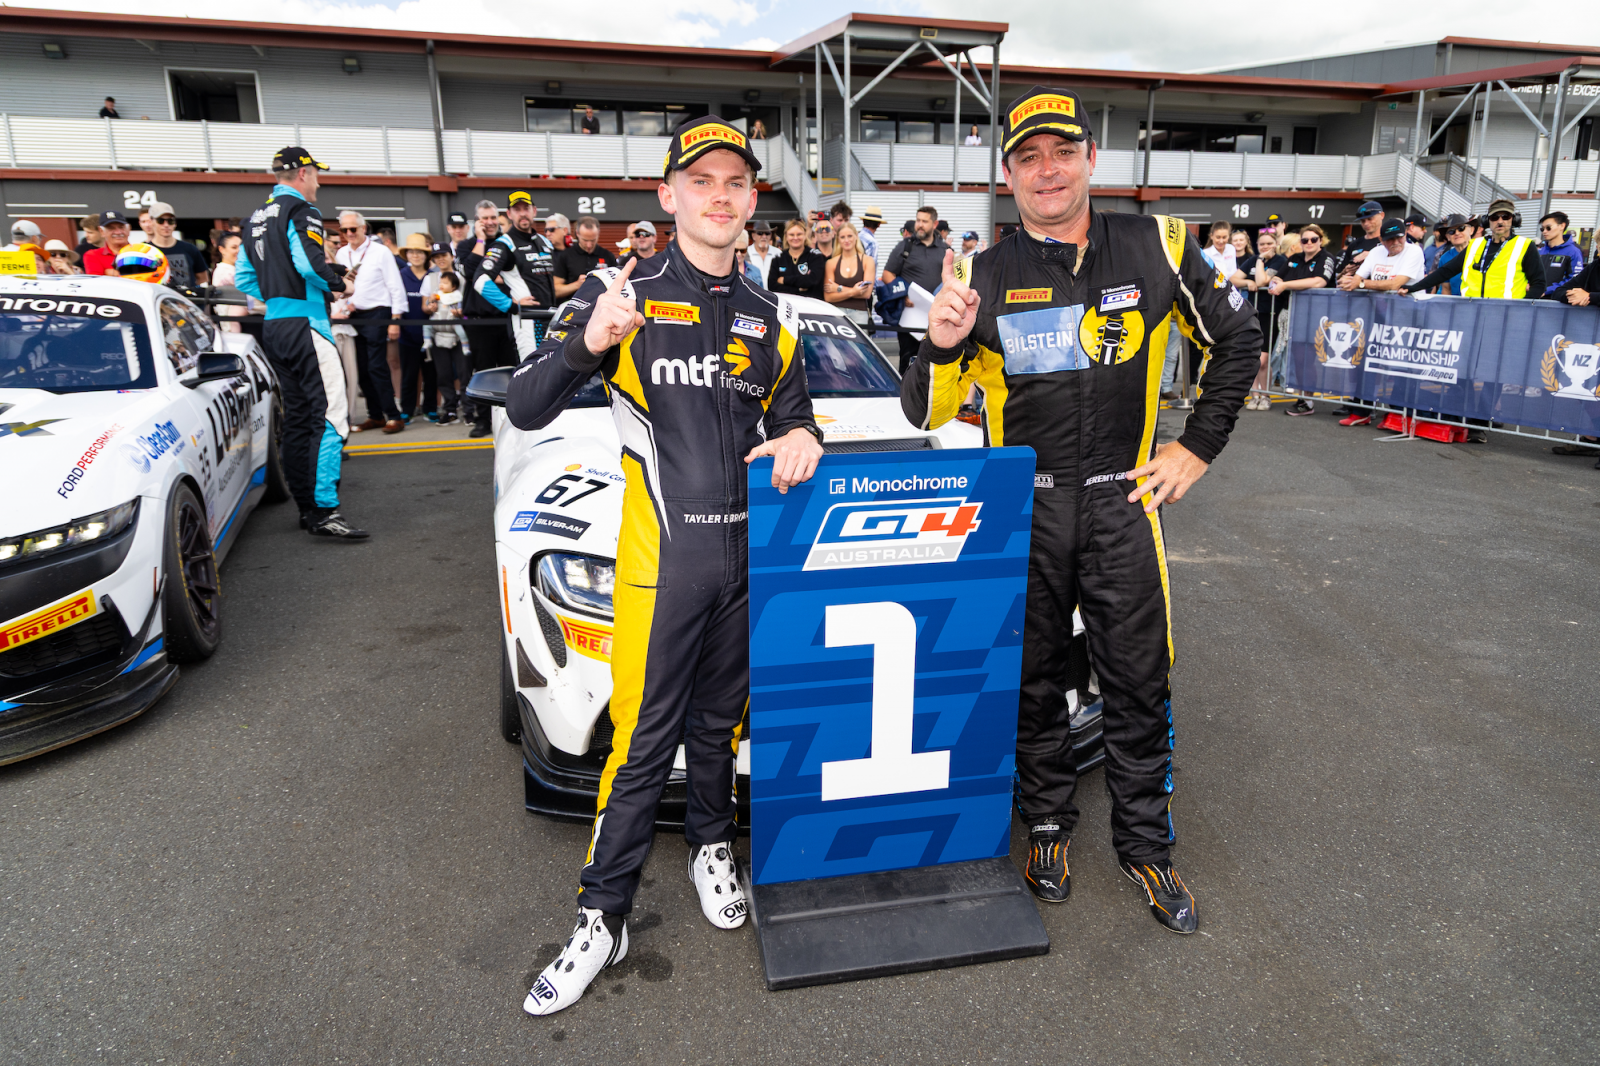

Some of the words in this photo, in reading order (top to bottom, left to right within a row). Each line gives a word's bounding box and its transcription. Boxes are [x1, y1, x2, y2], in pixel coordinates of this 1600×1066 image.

[1013, 97, 1070, 125] PIRELLI
[684, 126, 743, 147] PIRELLI
[123, 190, 158, 209] 24
[578, 197, 606, 213] 22
[1232, 204, 1250, 218] 18
[1308, 205, 1325, 218] 17
[1, 263, 31, 271] FERME
[1010, 290, 1048, 301] PIRELLI
[650, 304, 694, 320] PIRELLI
[1004, 330, 1074, 354] BILSTEIN
[1335, 330, 1347, 342] NZ
[1368, 323, 1464, 352] NEXTGEN
[1366, 343, 1460, 367] CHAMPIONSHIP
[1571, 353, 1592, 368] NZ
[651, 353, 721, 388] mtf
[1428, 368, 1455, 380] Repco
[719, 371, 766, 397] finance
[585, 468, 609, 477] Shell
[609, 474, 626, 483] Car
[852, 475, 968, 494] Monochrome
[1084, 473, 1115, 487] JEREMY
[1115, 471, 1130, 480] GR
[534, 473, 611, 508] 67
[536, 518, 584, 533] SILVER-AM
[684, 514, 721, 523] TAYLER
[839, 506, 980, 538] GT4
[823, 546, 946, 564] AUSTRALIA
[0, 596, 88, 650] PIRELLI
[821, 601, 951, 802] 1
[531, 978, 555, 1001] OMP
